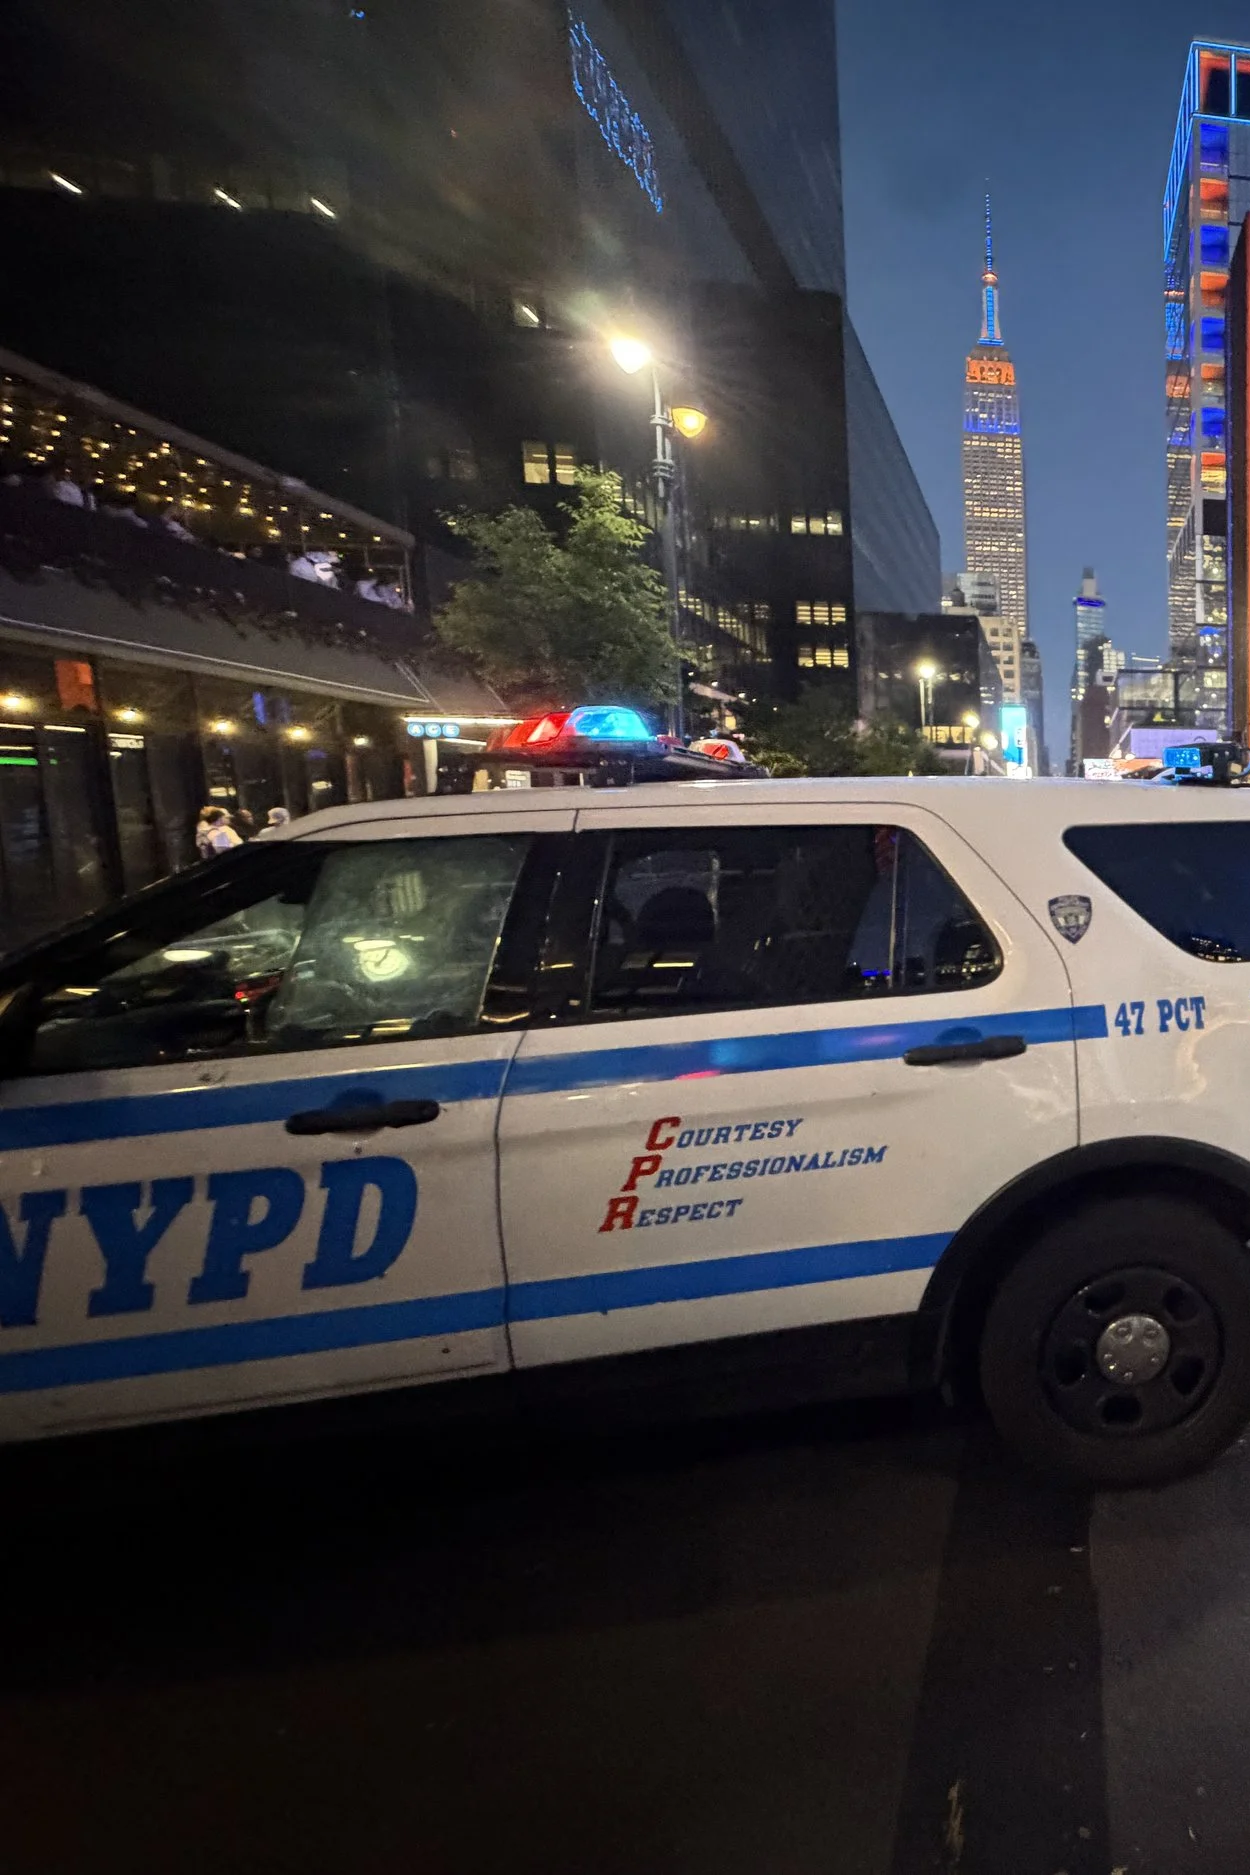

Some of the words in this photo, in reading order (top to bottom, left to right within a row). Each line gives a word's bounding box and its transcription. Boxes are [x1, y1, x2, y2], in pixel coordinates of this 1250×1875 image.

[1114, 1000, 1145, 1037] 47
[1156, 996, 1206, 1033] PCT
[645, 1116, 804, 1152] COURTESY
[620, 1145, 889, 1192] PROFESSIONALISM
[598, 1195, 744, 1233] RESPECT
[0, 1155, 418, 1328] NYPD
